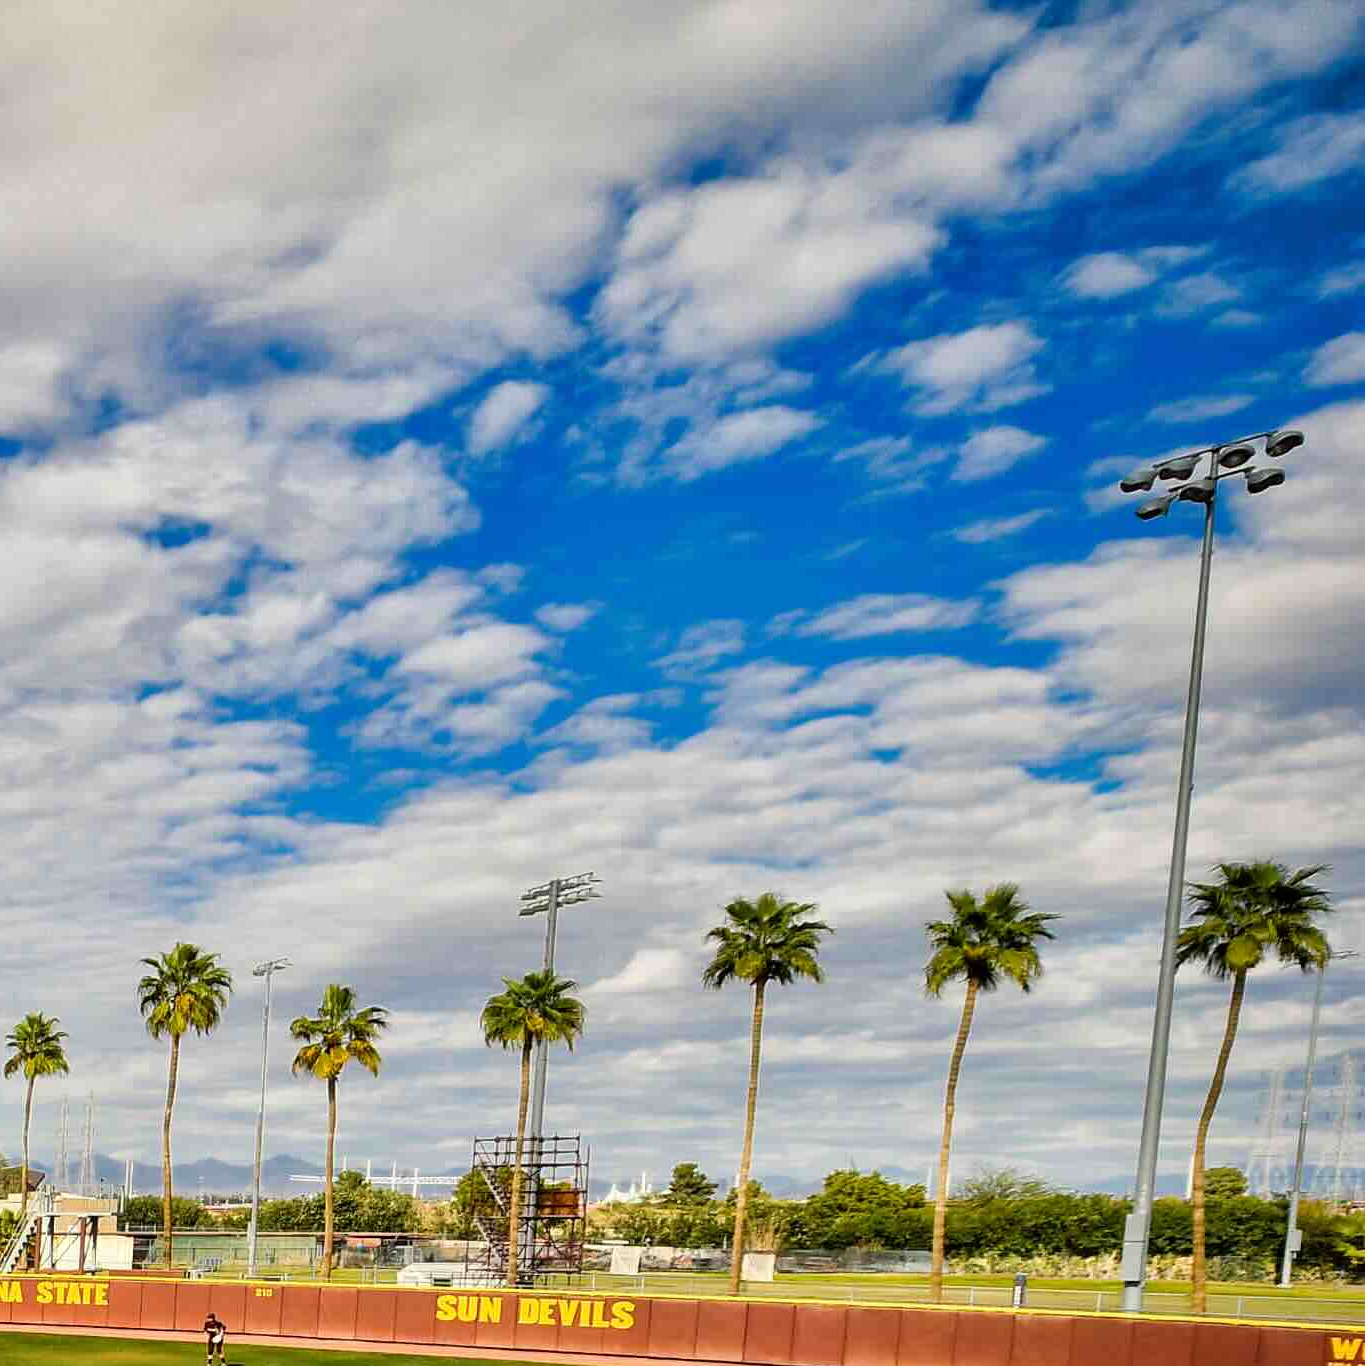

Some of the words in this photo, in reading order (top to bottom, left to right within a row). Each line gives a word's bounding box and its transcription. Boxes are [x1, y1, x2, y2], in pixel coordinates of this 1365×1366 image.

[36, 1282, 109, 1306] STATE
[436, 1294, 502, 1323] SUN
[517, 1297, 635, 1329] DEVILS
